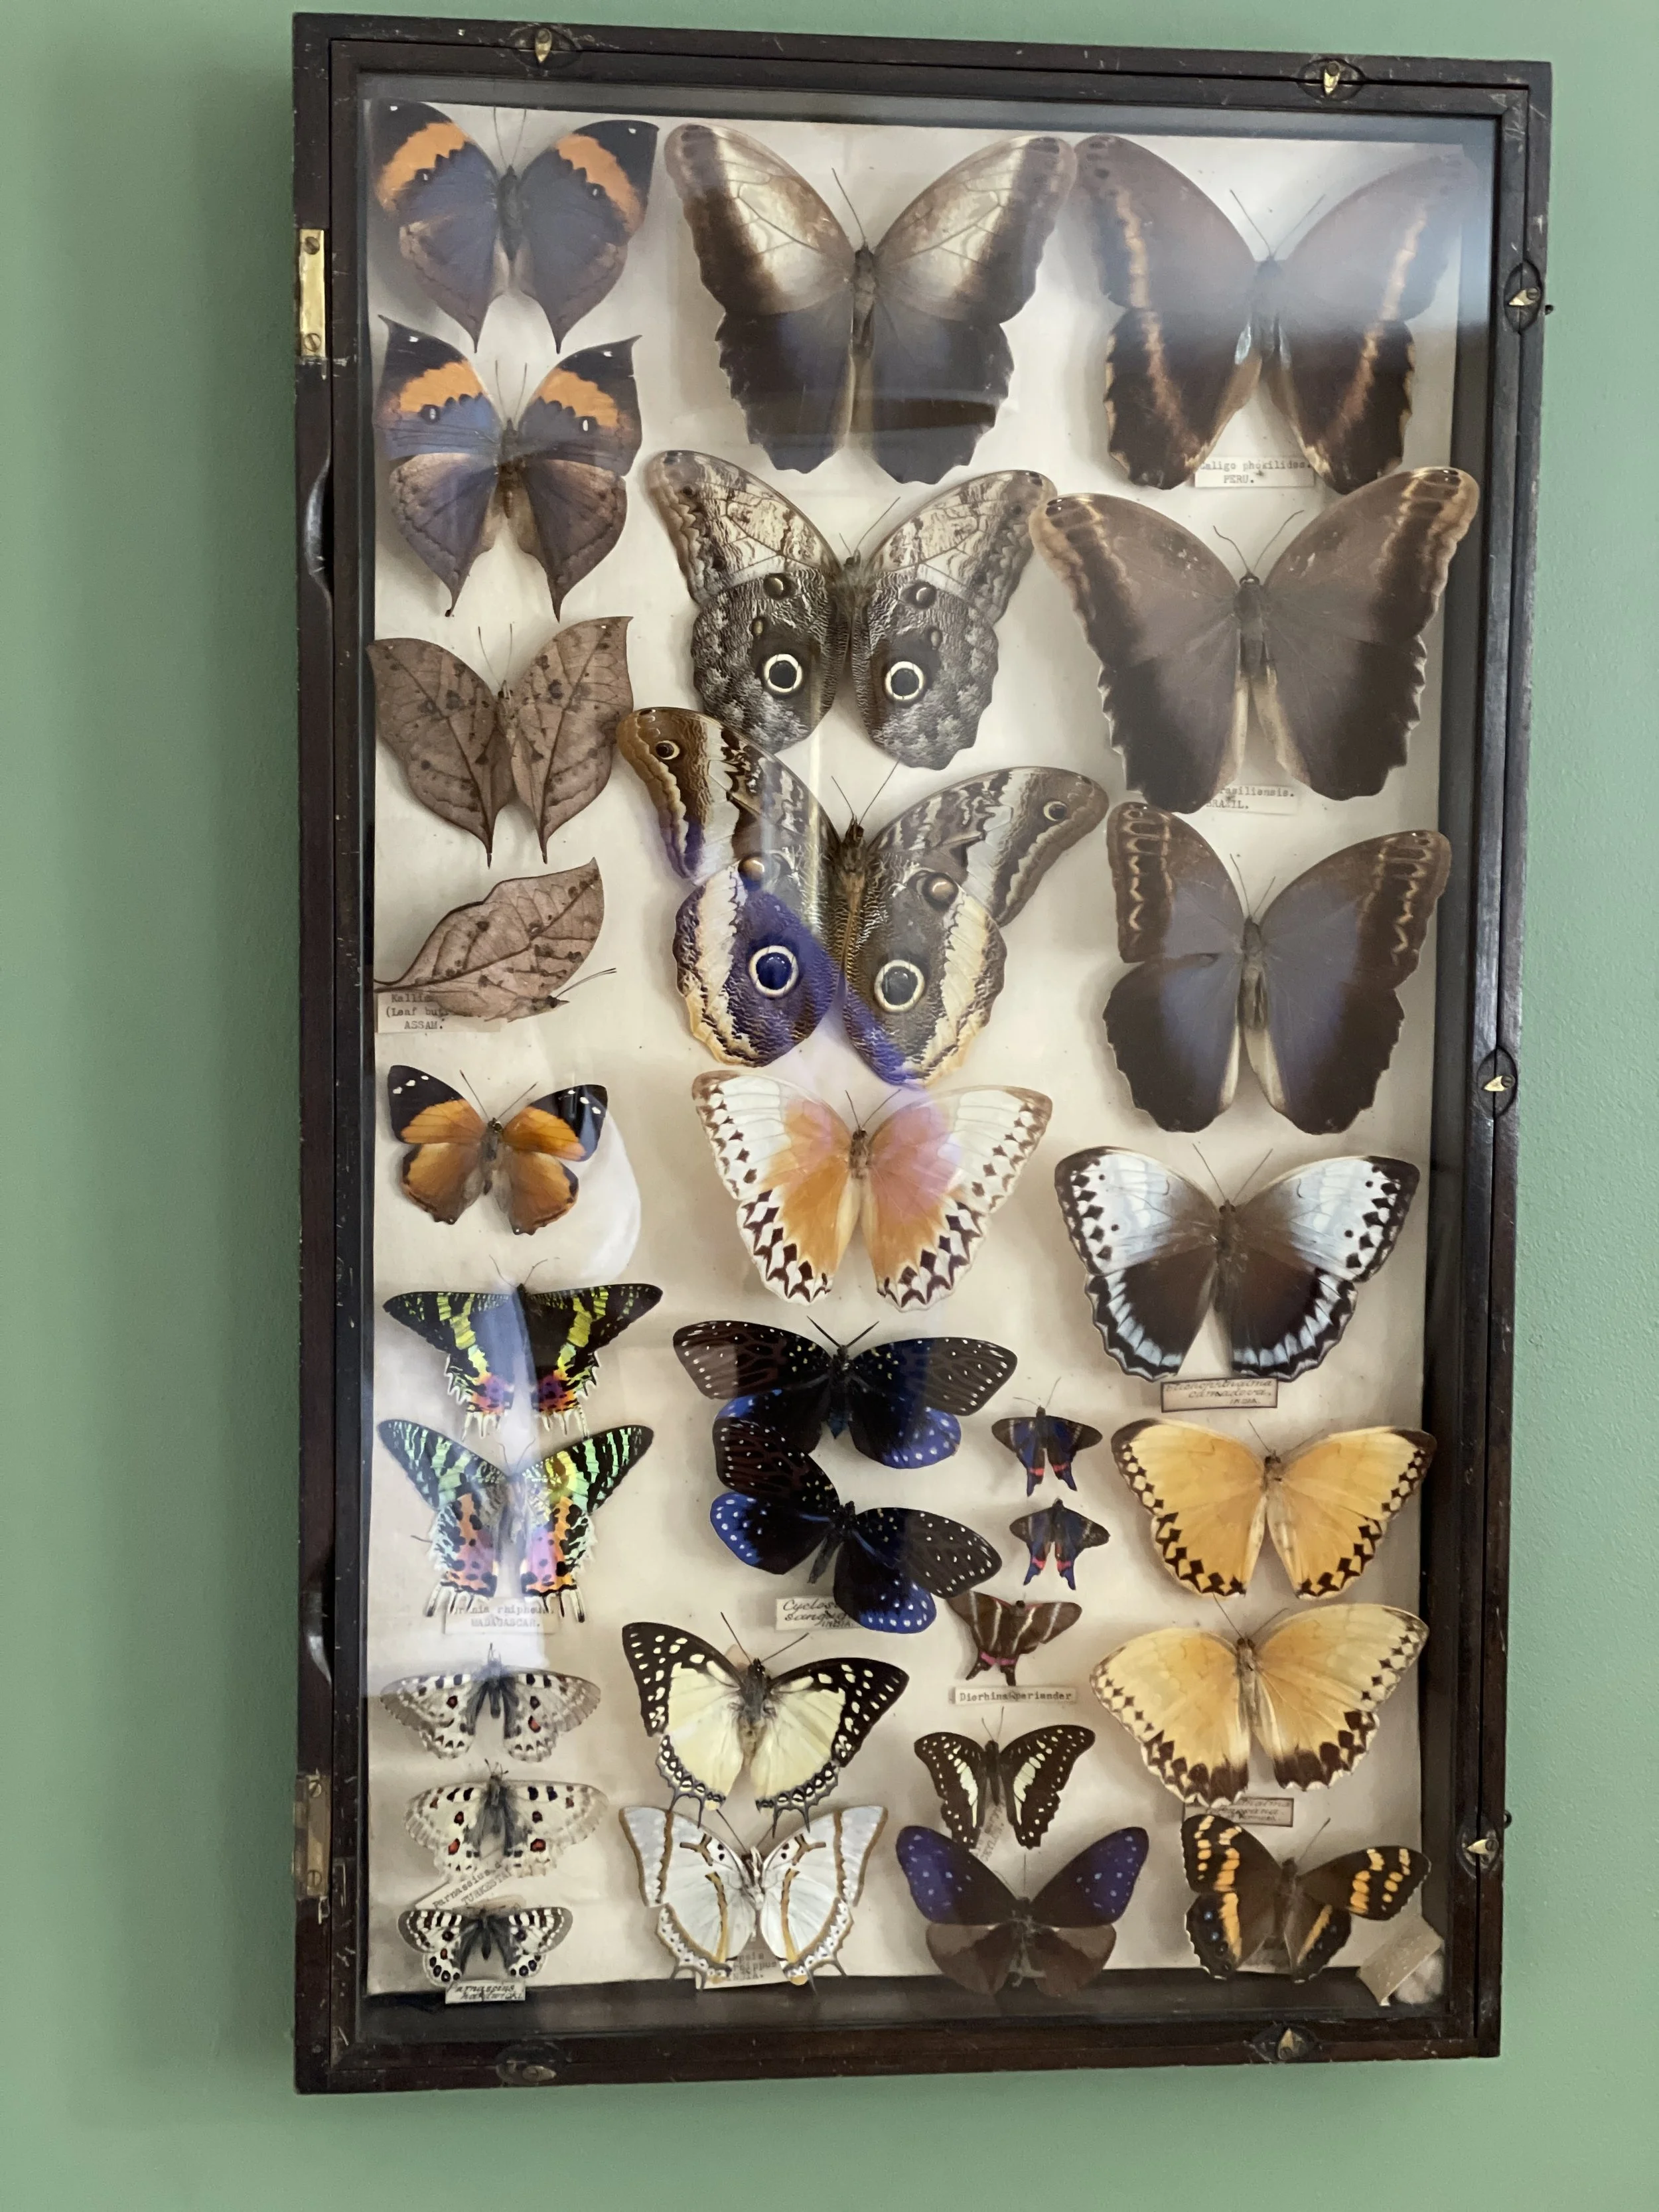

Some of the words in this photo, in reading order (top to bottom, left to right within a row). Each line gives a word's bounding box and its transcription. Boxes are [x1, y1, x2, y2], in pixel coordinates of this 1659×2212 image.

[1223, 475, 1254, 484] PERU.
[386, 1006, 417, 1017] (Leaf
[403, 1020, 443, 1030] ASSAM.
